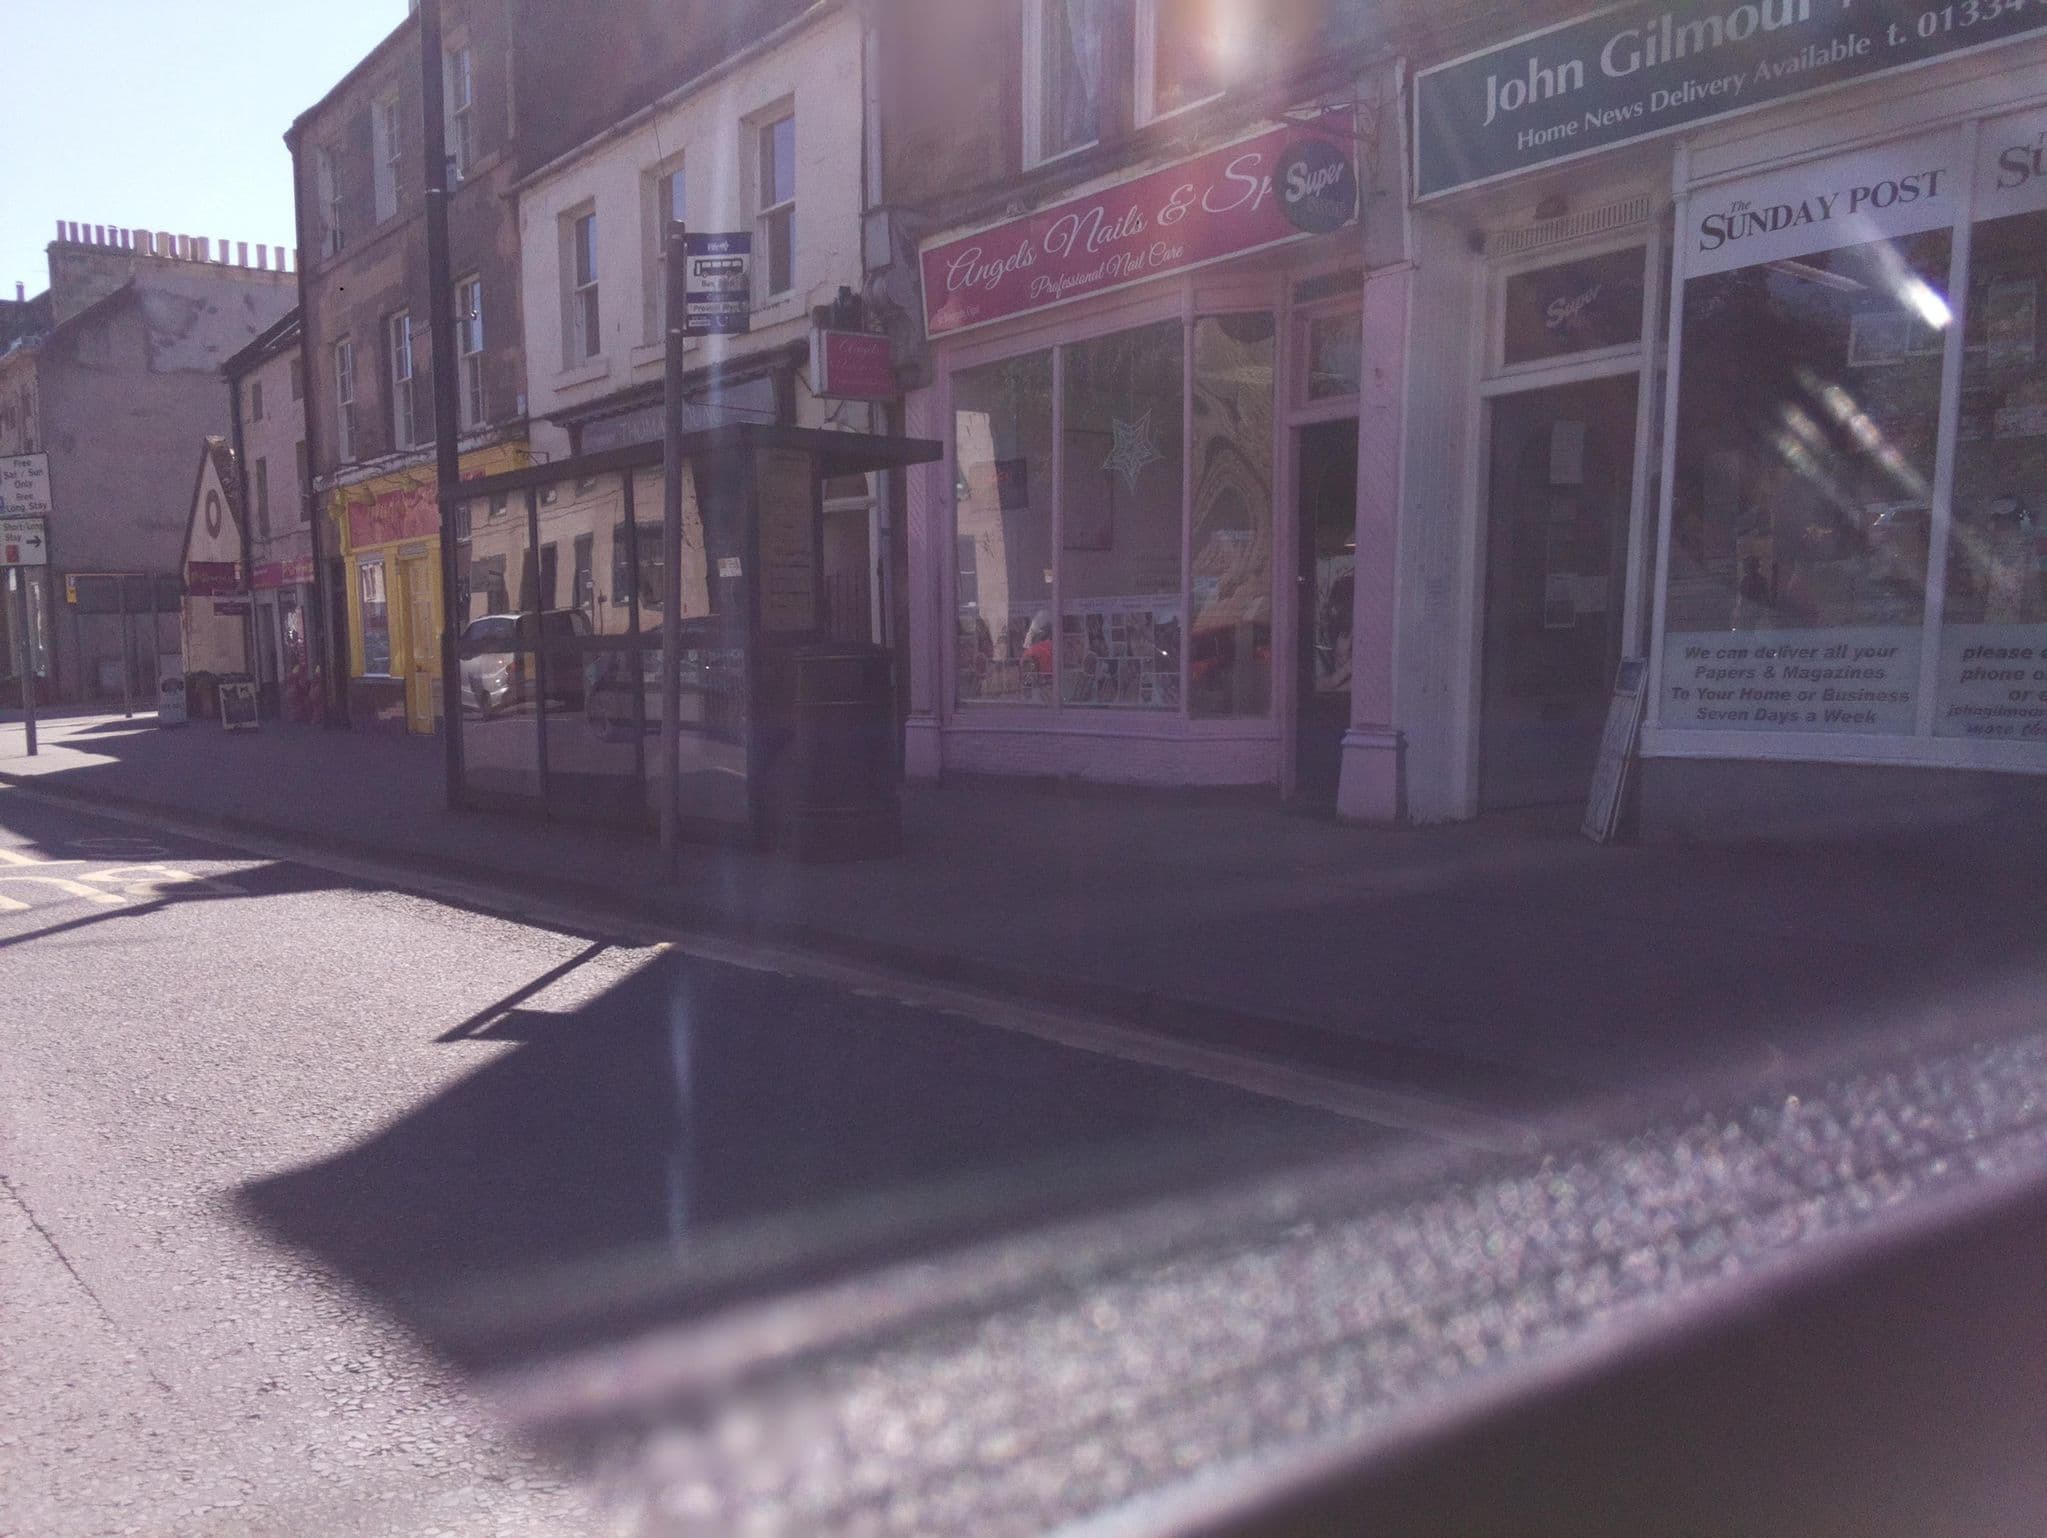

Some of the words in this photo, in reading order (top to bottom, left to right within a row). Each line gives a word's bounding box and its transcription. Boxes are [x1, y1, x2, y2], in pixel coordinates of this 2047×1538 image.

[1483, 54, 1584, 127] John
[1517, 119, 1578, 152] Home
[1584, 100, 1644, 131] News
[1650, 69, 1748, 114] Delivery
[1753, 33, 1871, 84] Available
[1285, 161, 1345, 203] Super
[946, 240, 1037, 292] Angels
[1043, 205, 1148, 258] Nails
[1157, 184, 1197, 226] &
[1201, 152, 1273, 214] Sp
[1699, 192, 1840, 253] SUNDAY
[1848, 168, 1947, 216] POST
[1030, 265, 1105, 299] Professional
[1106, 254, 1147, 278] Nail
[1148, 240, 1184, 268] Care
[1545, 284, 1602, 328] Super
[1684, 645, 1710, 660] We
[1716, 647, 1748, 659] can
[1754, 645, 1820, 660] deliver
[1823, 643, 1849, 659] all
[1853, 645, 1899, 661] your
[1961, 645, 2033, 662] please
[1694, 665, 1756, 681] Papers
[1763, 666, 1776, 680] &
[1782, 665, 1887, 682] Magazines
[1960, 666, 2025, 684] phone
[1671, 686, 1690, 700] To
[1696, 687, 1735, 701] Your
[1739, 687, 1792, 702] Home
[1797, 690, 1816, 702] or
[1821, 687, 1911, 703] Business
[2008, 689, 2033, 702] or
[1696, 706, 1754, 722] Seven
[1755, 707, 1798, 725] Days
[1805, 711, 1817, 723] a
[1823, 708, 1878, 724] Week
